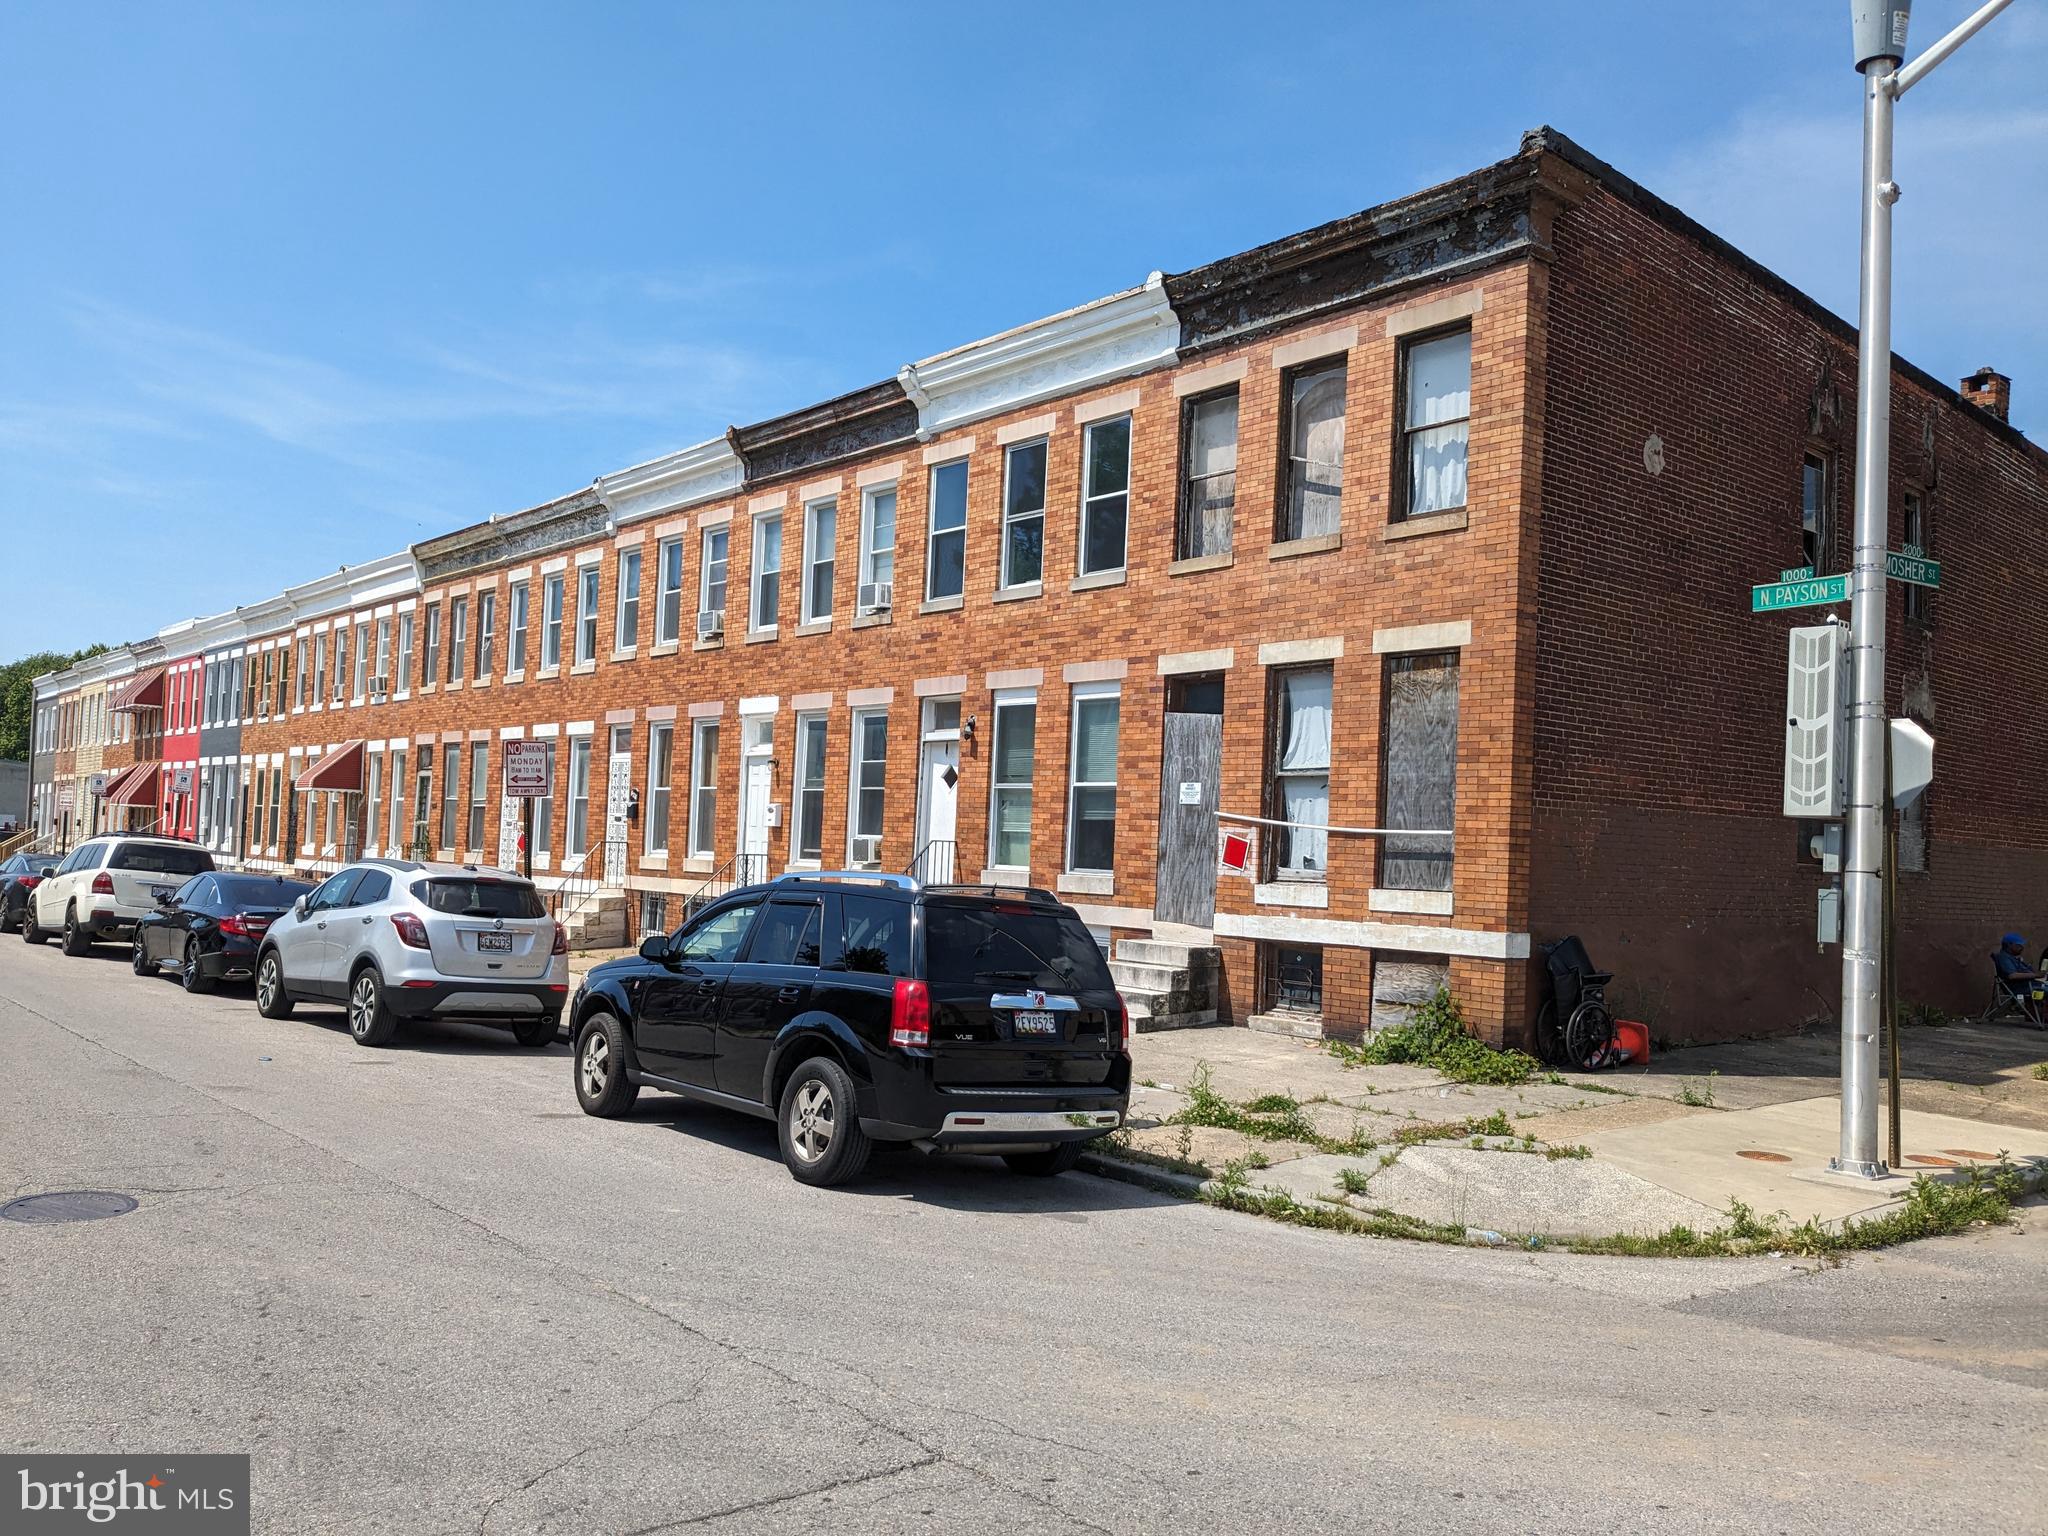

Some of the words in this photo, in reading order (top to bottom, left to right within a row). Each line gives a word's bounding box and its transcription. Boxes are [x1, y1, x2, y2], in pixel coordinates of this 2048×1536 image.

[1903, 544, 1921, 558] 2000
[1782, 568, 1807, 582] 1000
[1761, 590, 1772, 606] N.
[1776, 582, 1828, 604] PAYSON
[508, 743, 520, 755] NO
[521, 745, 545, 753] PARKING
